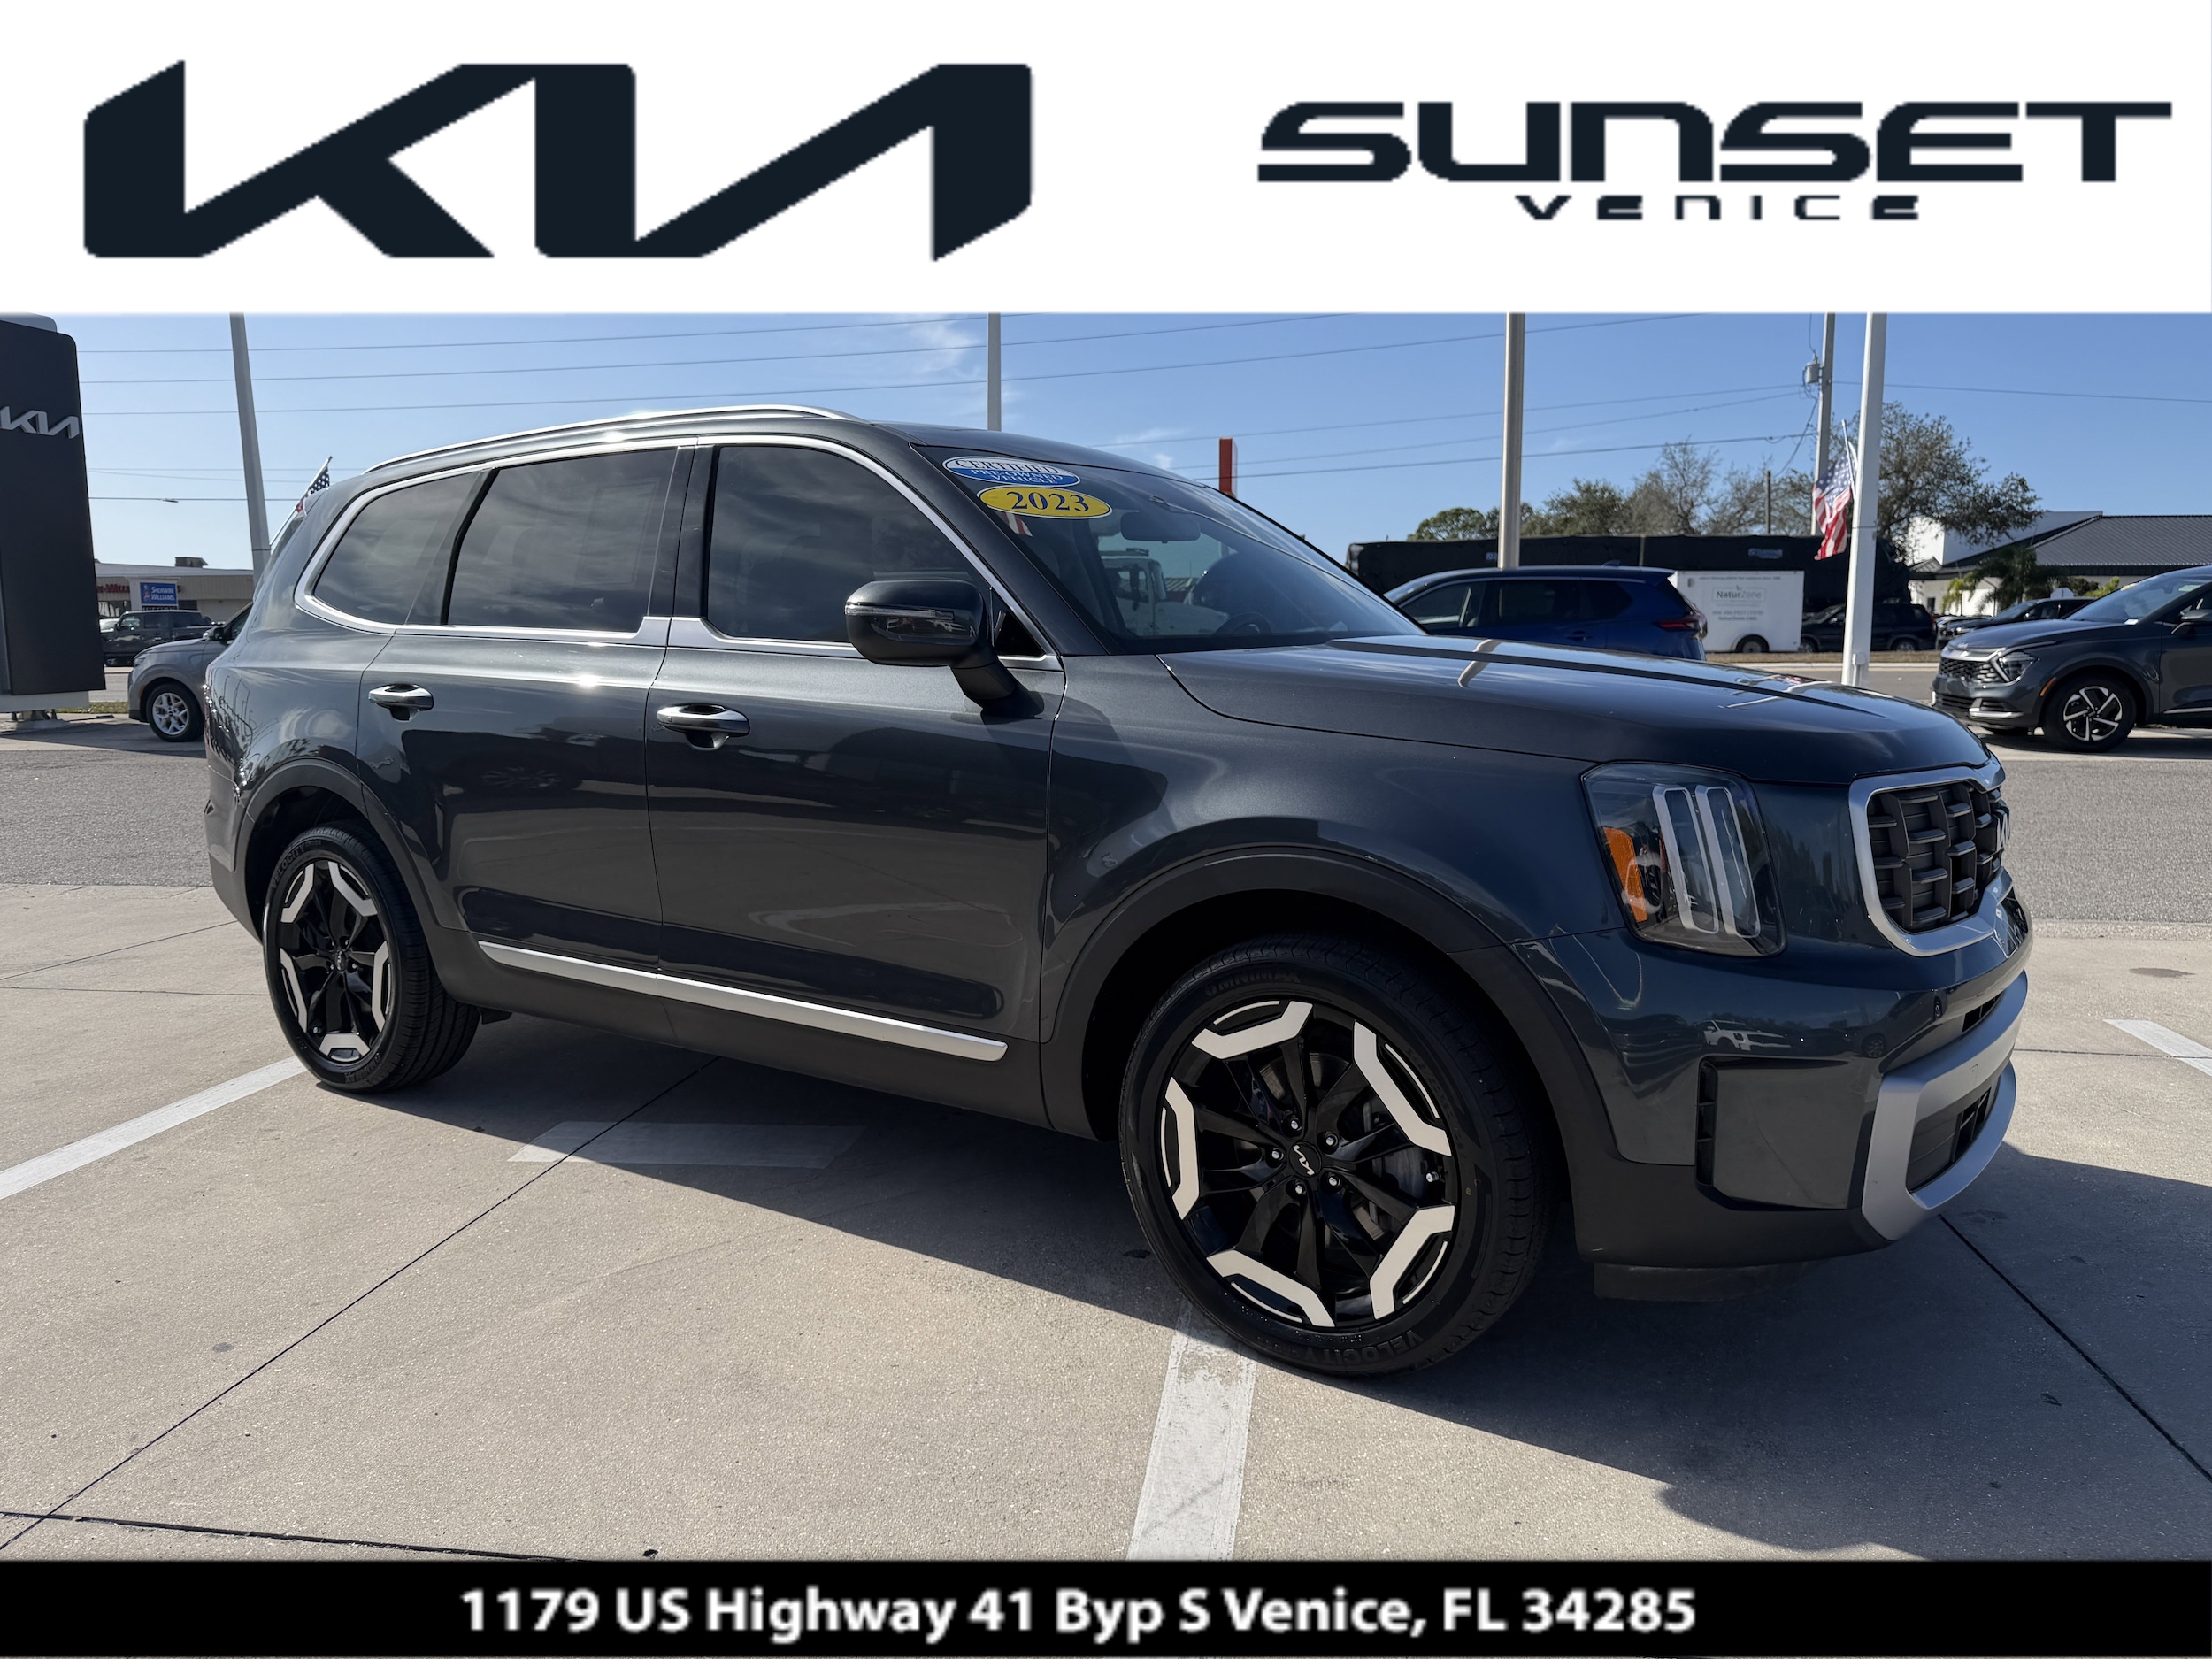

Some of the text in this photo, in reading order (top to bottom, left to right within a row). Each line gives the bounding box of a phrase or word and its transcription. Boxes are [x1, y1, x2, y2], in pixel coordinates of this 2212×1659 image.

[0, 406, 80, 439] KIA
[955, 459, 1059, 474] CERTIFIED
[972, 469, 1064, 481] PRE-OWNED
[991, 473, 1058, 484] VEHICLE
[1006, 491, 1089, 512] 2023
[1716, 589, 1762, 599] NaturZone
[1304, 1329, 1425, 1364] VELOCITY
